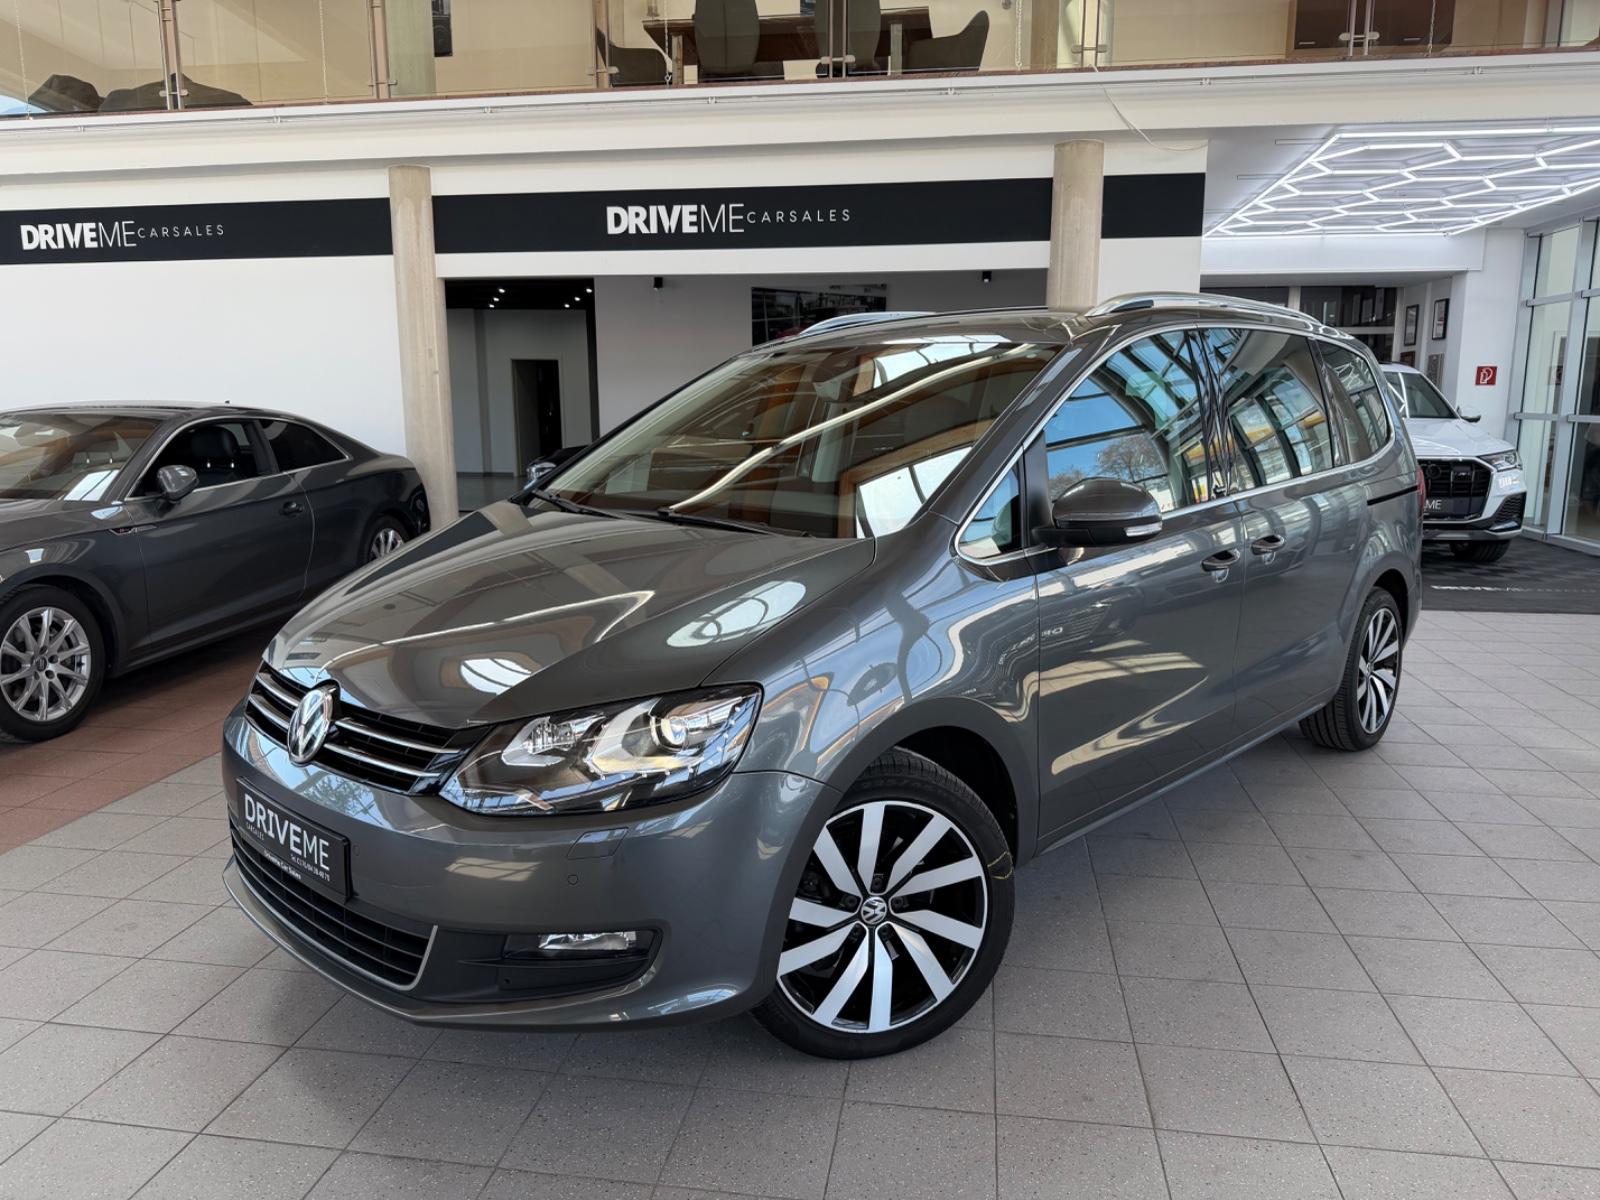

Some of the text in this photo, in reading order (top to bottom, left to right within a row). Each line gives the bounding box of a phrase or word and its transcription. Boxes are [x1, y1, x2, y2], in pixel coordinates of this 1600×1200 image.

[606, 203, 851, 235] DRIVEME CARSALES
[20, 221, 224, 250] DRIVEME CARSALES
[244, 793, 330, 871] DRIVEME
